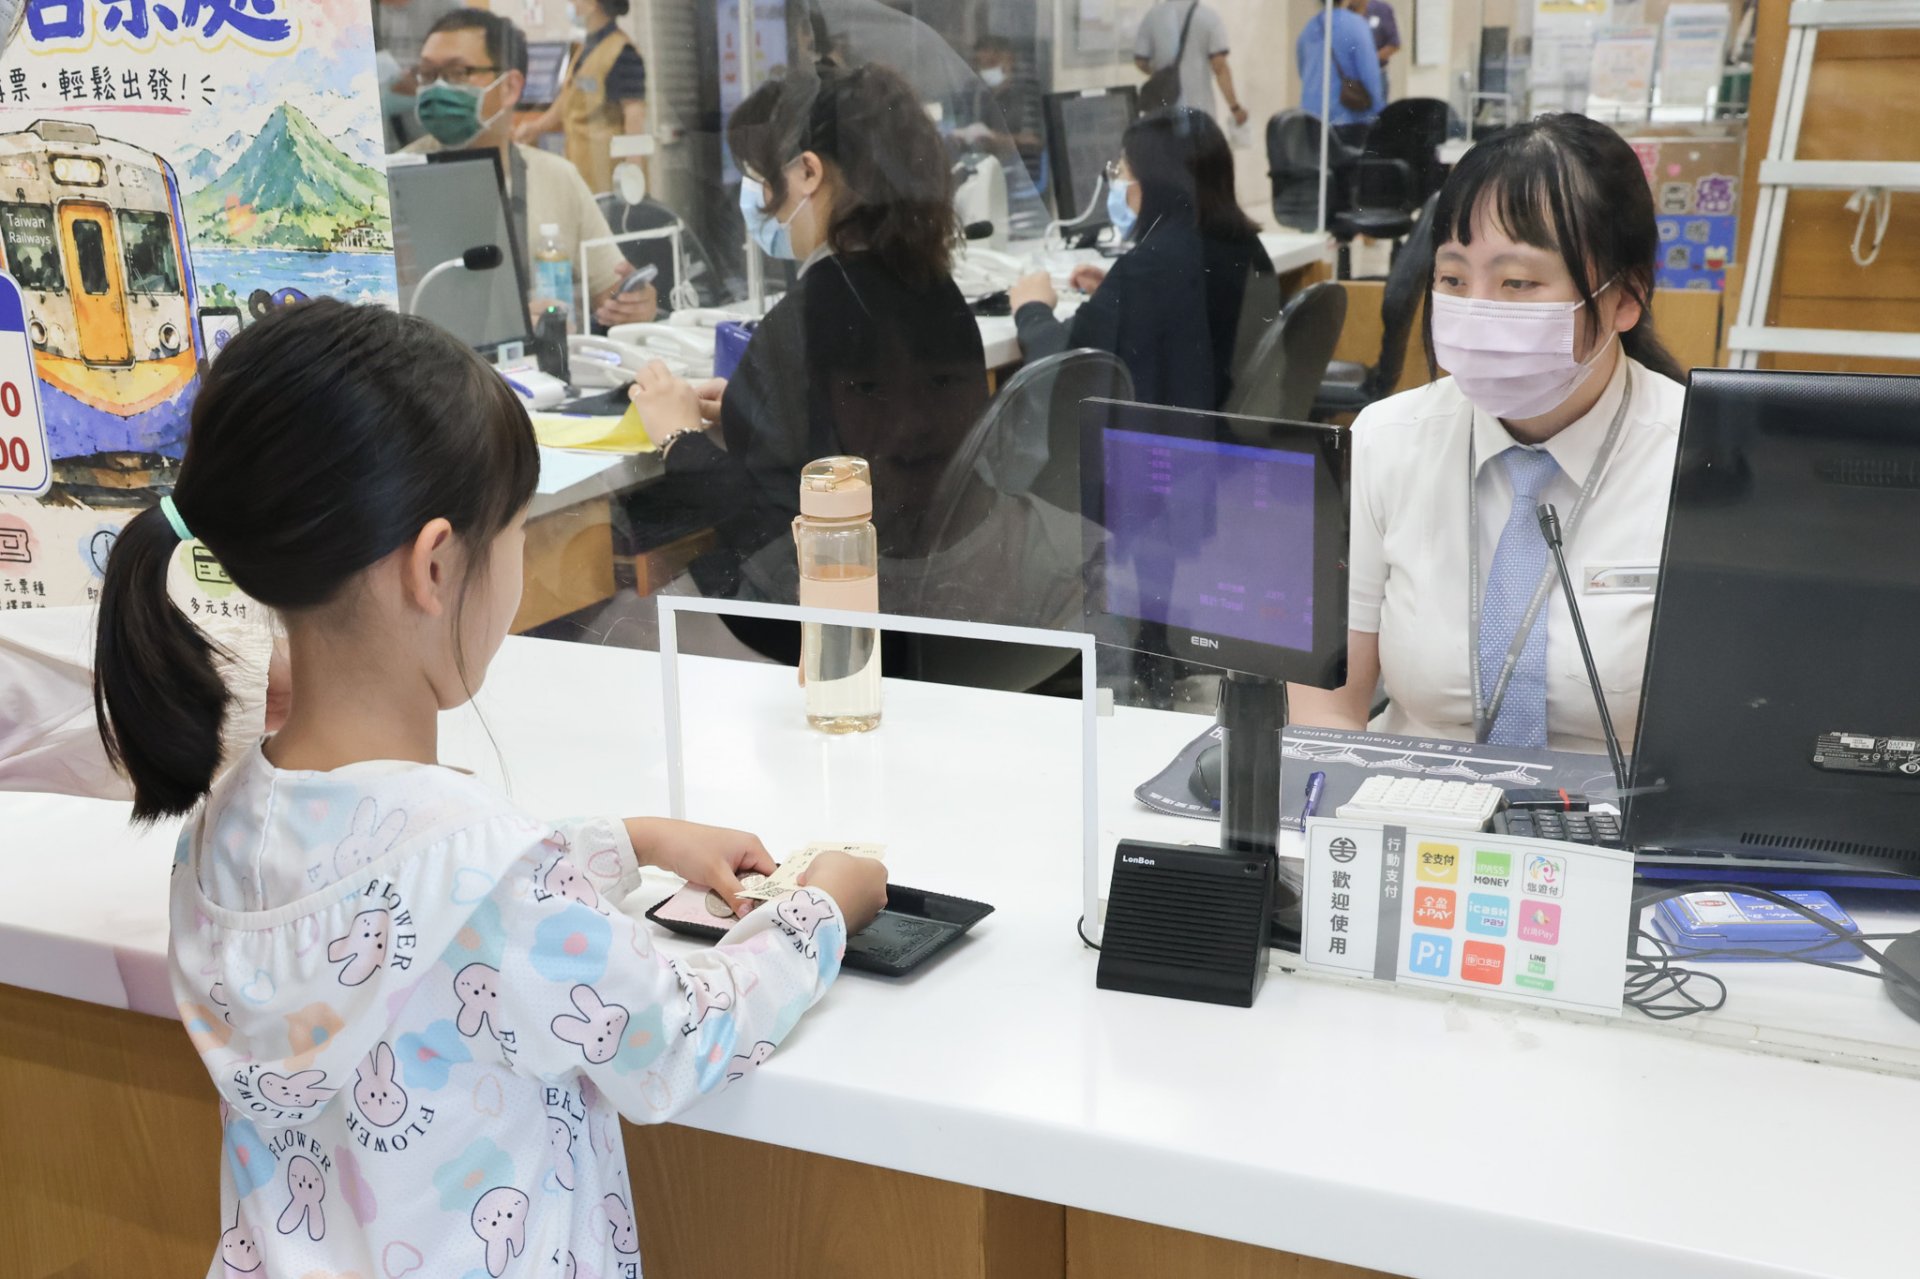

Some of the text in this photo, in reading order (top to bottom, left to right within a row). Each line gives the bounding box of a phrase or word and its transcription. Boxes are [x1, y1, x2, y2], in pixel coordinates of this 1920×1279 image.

[6, 212, 46, 229] Taiwan
[9, 231, 52, 247] Railways
[191, 597, 247, 619] 多元支付
[1191, 635, 1219, 650] EBN
[1293, 729, 1343, 740] Station
[1347, 734, 1402, 747] Hualien
[1122, 854, 1156, 866] LonBon
[1422, 852, 1455, 867] 全支付
[1384, 838, 1402, 899] 行動支付
[1477, 863, 1505, 876] iPASS
[1473, 875, 1510, 888] MONEY
[1328, 870, 1351, 956] 歡迎使用
[363, 879, 417, 971] FLOWER
[1416, 940, 1446, 969] Pi
[1529, 953, 1548, 963] LINE
[345, 1104, 435, 1154] FLOWER
[268, 1128, 332, 1174] FLOWER
